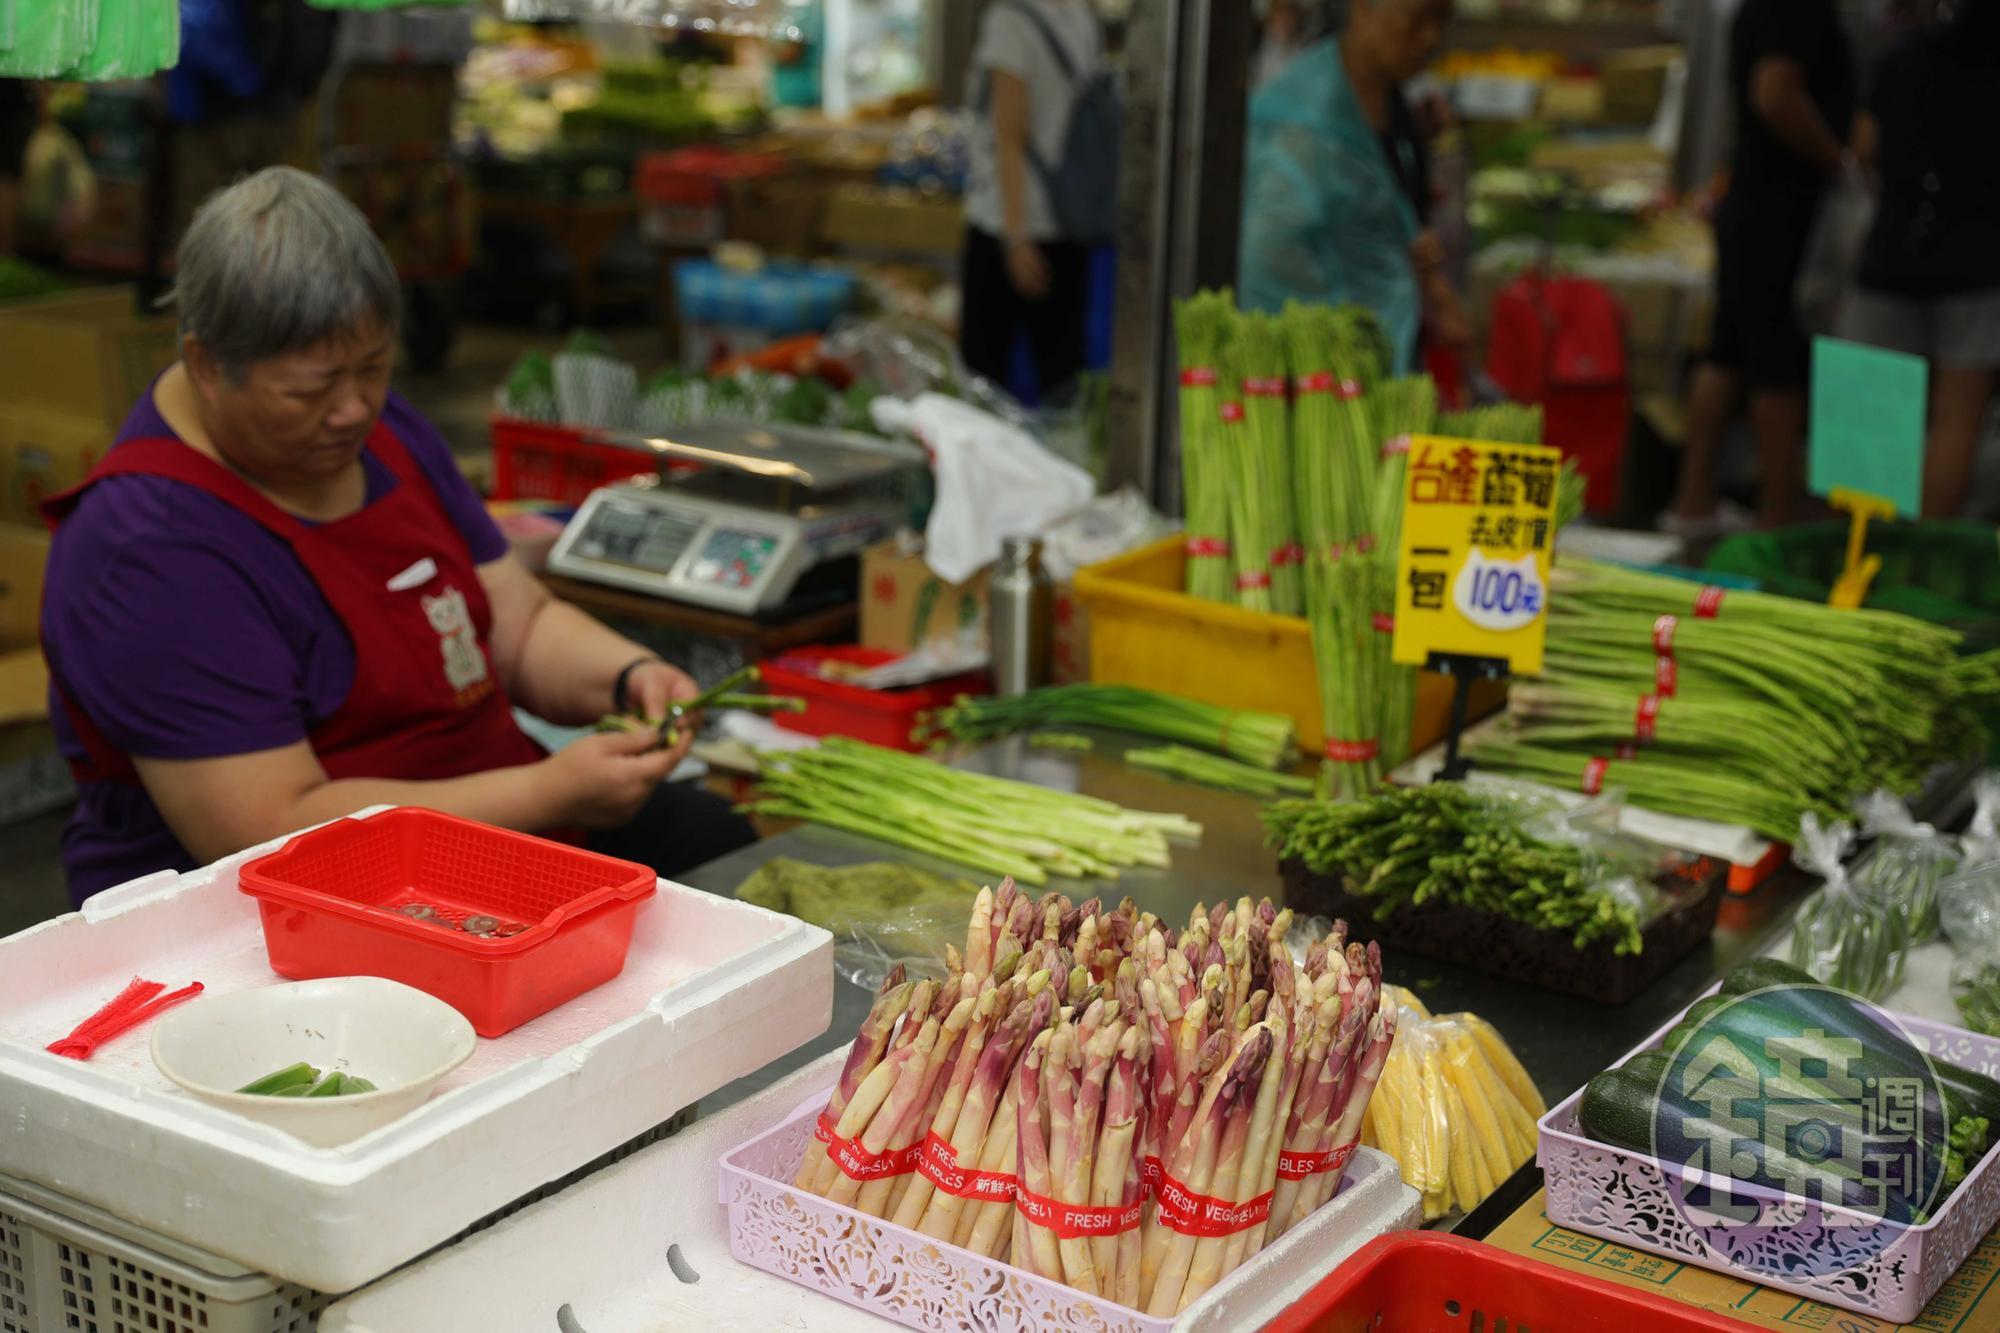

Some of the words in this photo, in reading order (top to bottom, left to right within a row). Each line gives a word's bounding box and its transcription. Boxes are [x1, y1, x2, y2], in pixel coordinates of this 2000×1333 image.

[1278, 1157, 1315, 1173] BLES
[1162, 1183, 1199, 1215] FRESH
[1064, 1212, 1112, 1229] FRESH
